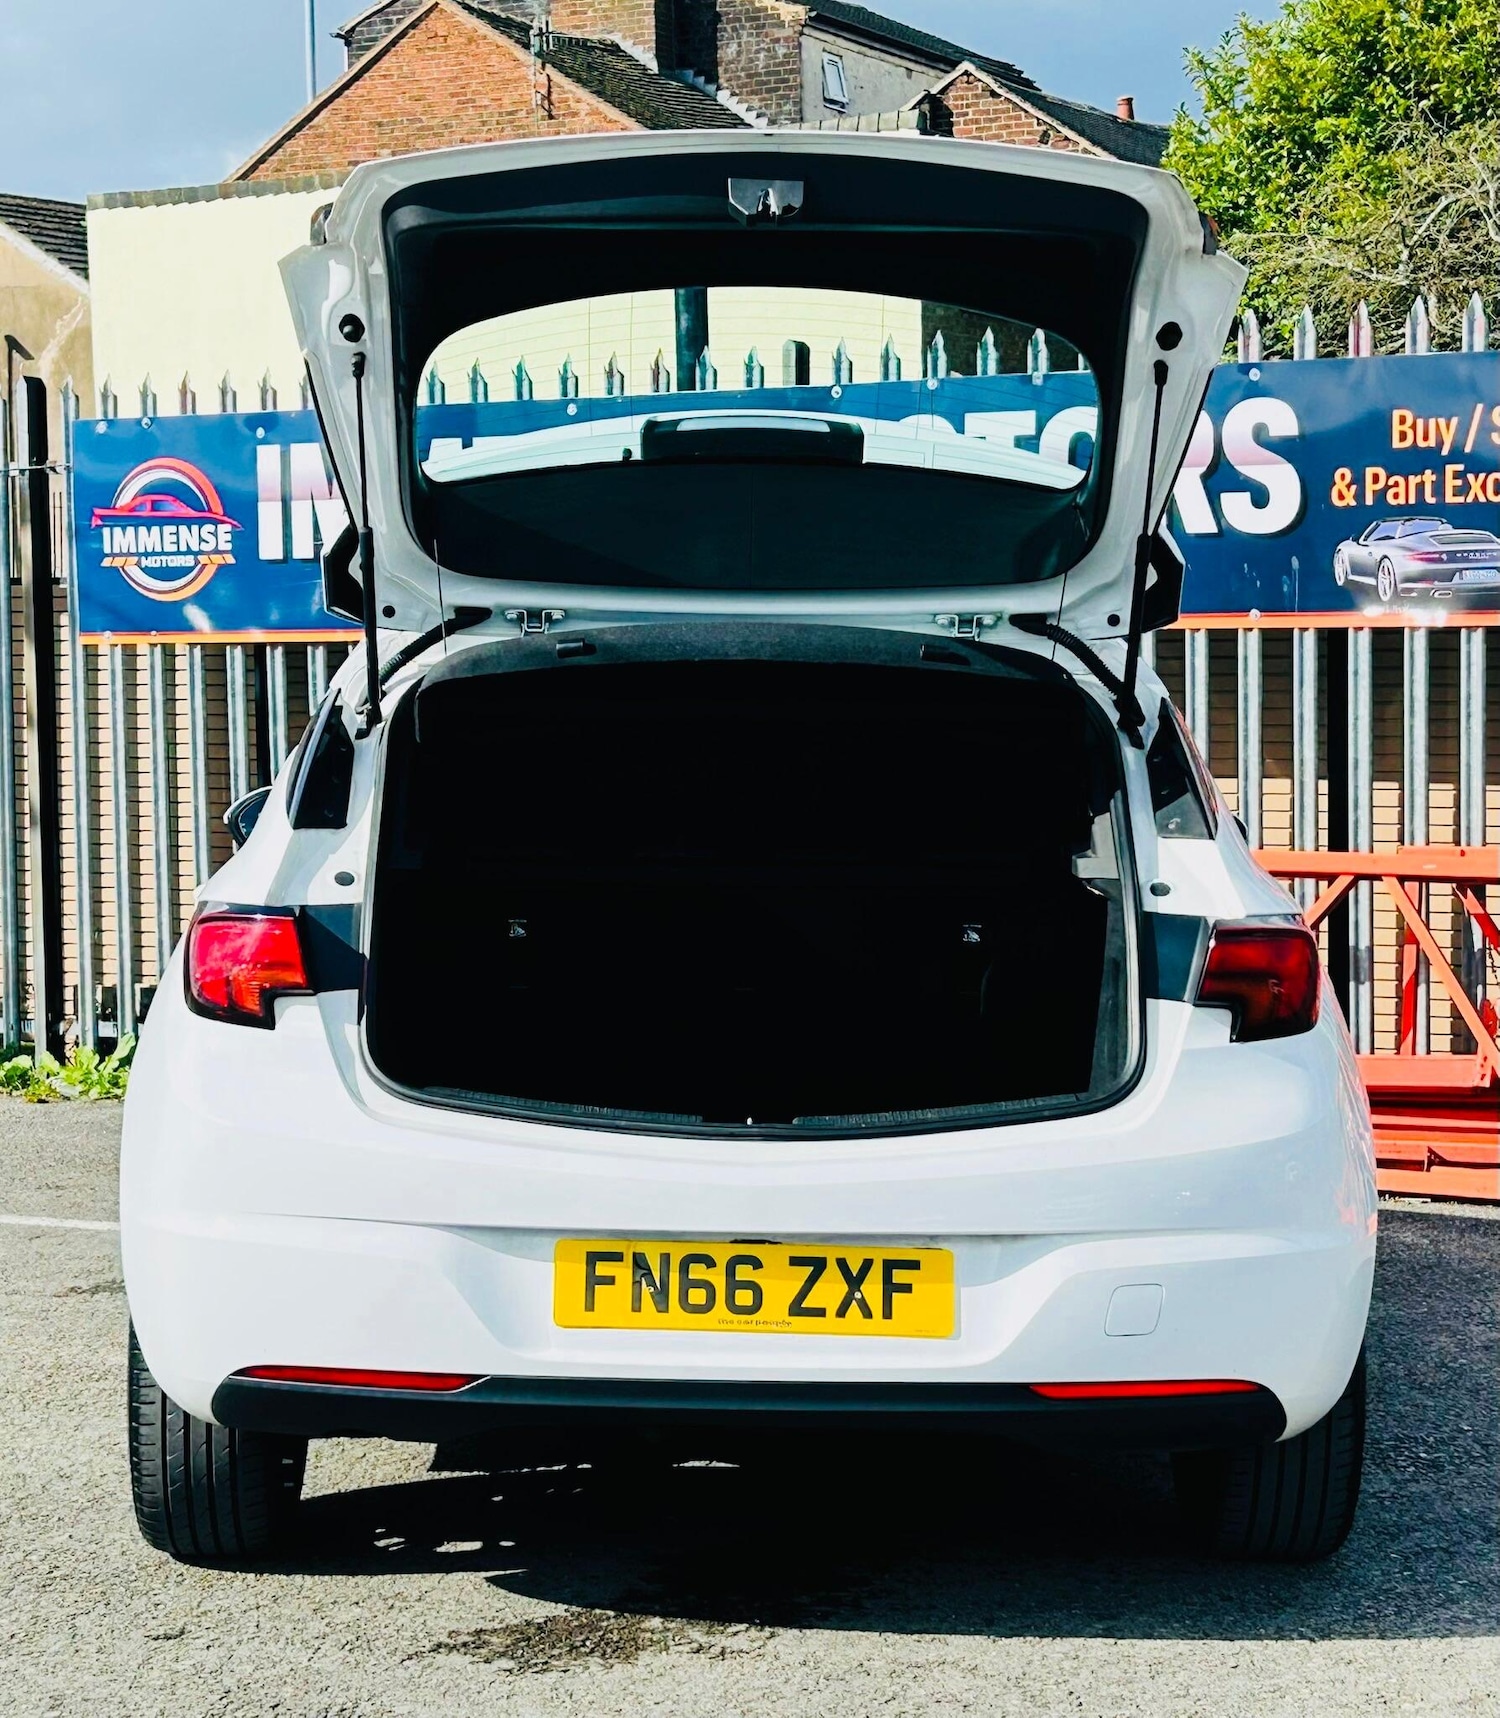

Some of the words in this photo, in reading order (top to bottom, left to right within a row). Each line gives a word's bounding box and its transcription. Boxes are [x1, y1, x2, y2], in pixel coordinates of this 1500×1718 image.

[1391, 408, 1458, 456] Buy
[1464, 403, 1484, 453] /
[1331, 467, 1358, 507] &
[1365, 466, 1437, 506] Part
[102, 524, 232, 555] IMMENSE
[141, 555, 195, 568] MOTORS
[584, 1251, 764, 1316] FN66
[788, 1255, 922, 1320] ZXF
